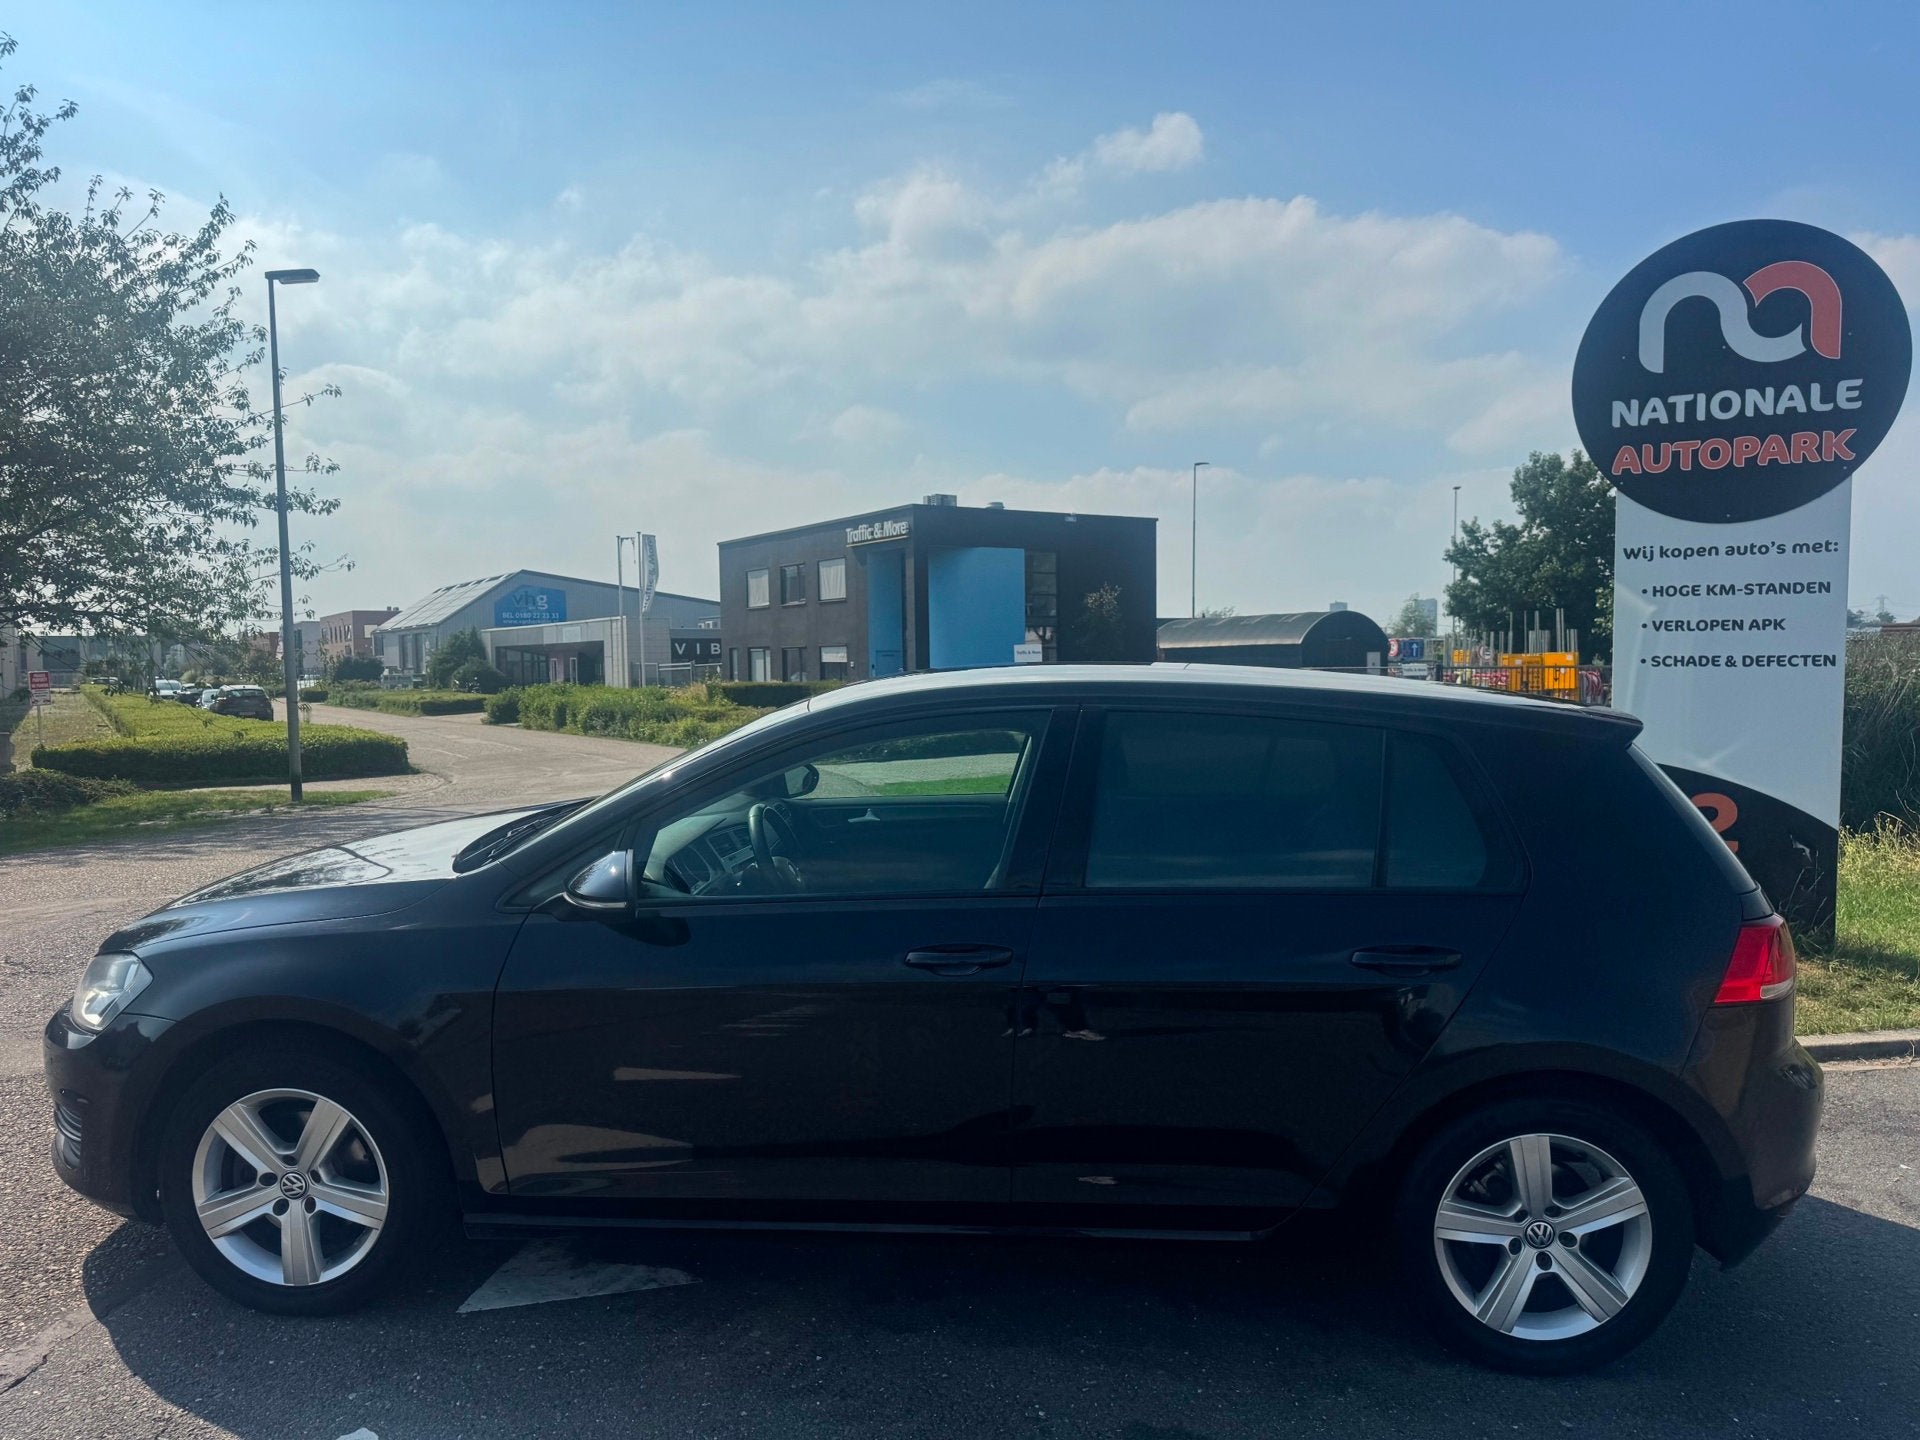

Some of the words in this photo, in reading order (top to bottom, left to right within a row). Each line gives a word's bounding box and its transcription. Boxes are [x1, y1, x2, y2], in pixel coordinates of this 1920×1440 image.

[1611, 378, 1864, 428] NATIONALE
[1611, 428, 1858, 475] AUTOPARK
[845, 524, 874, 543] Traffic
[874, 522, 882, 538] &
[883, 520, 908, 536] More
[1659, 545, 1719, 560] kopen
[1725, 541, 1787, 556] auto's
[1792, 540, 1839, 554] met:
[1652, 584, 1701, 597] HOGE
[1706, 581, 1831, 596] KM-STANDEN
[1652, 619, 1744, 632] VERLOPEN
[1748, 618, 1786, 631] APK
[1651, 655, 1721, 667] SCHADE
[1725, 655, 1737, 667] &
[1742, 654, 1836, 667] DEFECTEN
